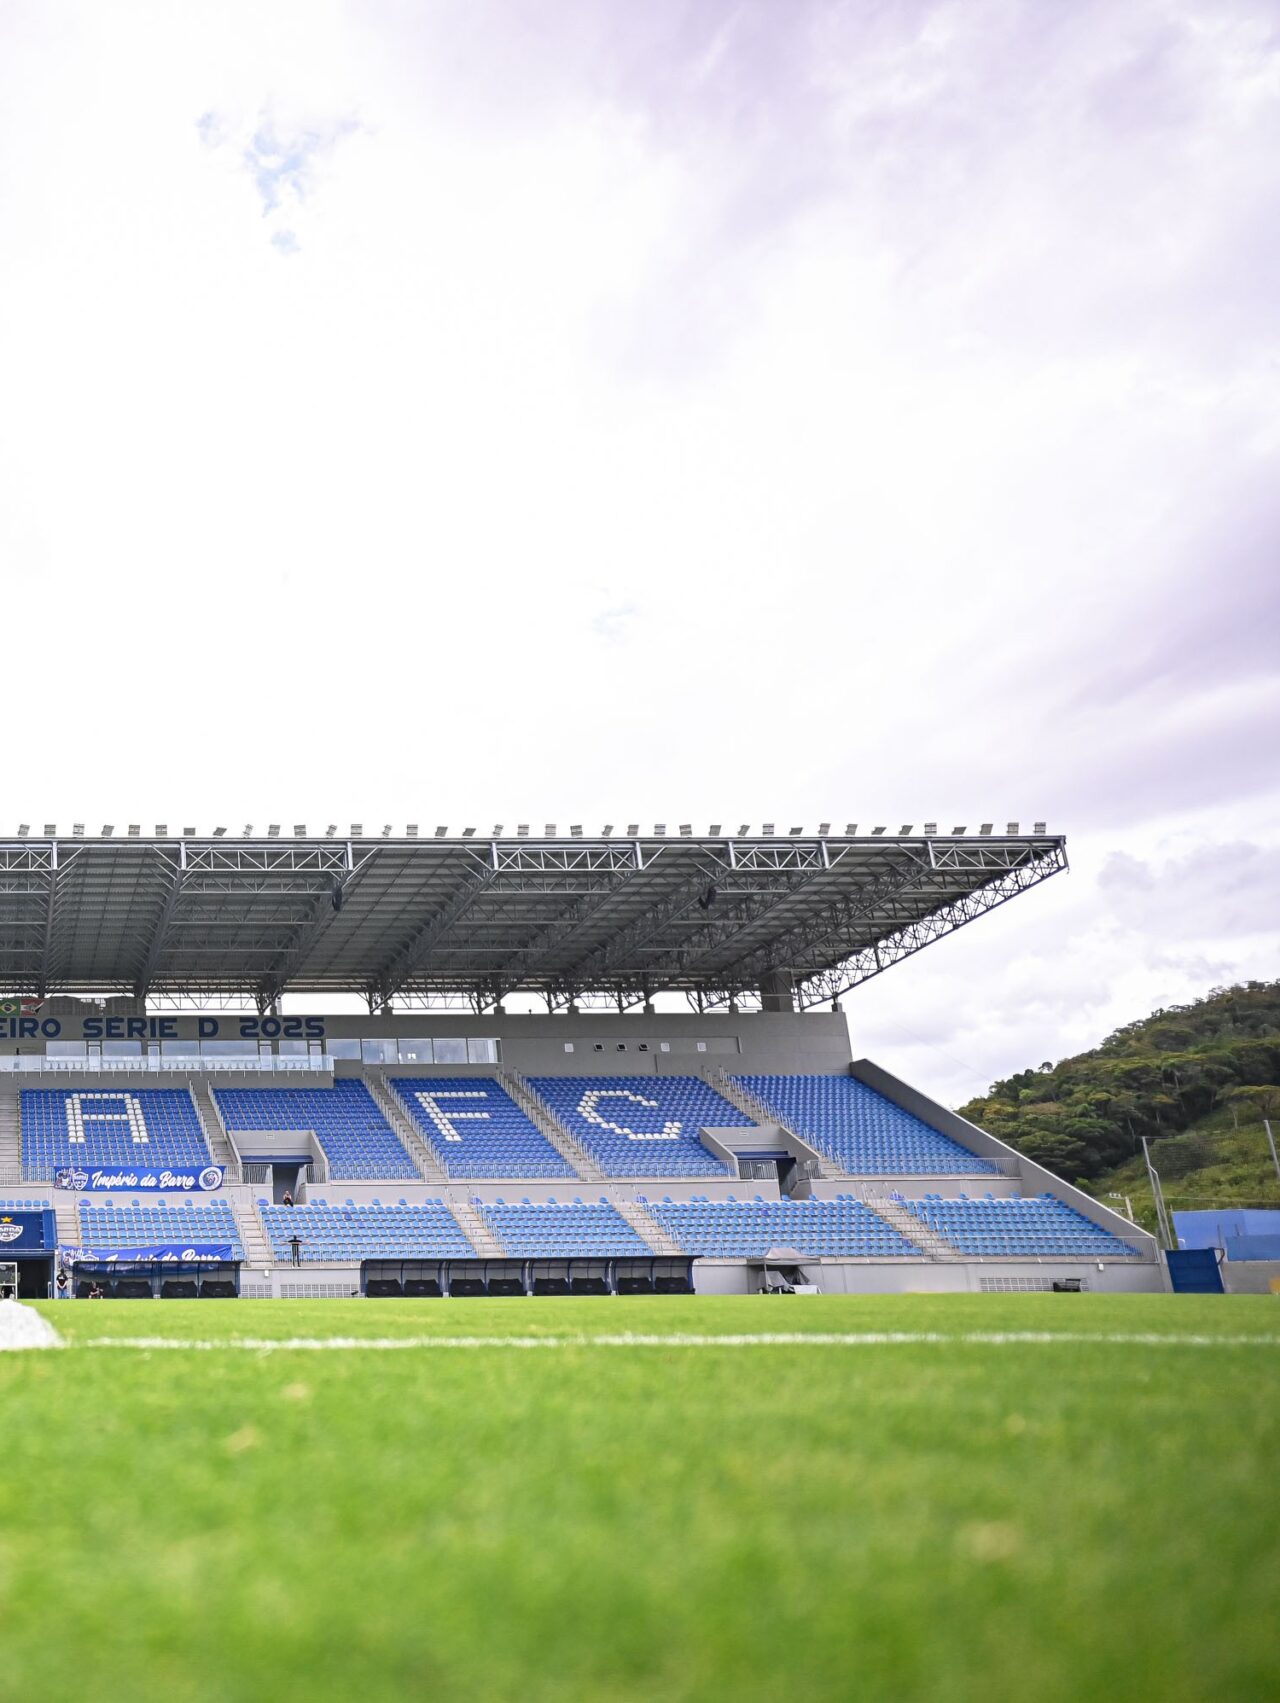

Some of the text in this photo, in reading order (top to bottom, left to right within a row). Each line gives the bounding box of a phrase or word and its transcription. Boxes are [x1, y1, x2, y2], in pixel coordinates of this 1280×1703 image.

[198, 1017, 219, 1038] D
[238, 1017, 326, 1038] 2025
[91, 1171, 196, 1190] Império da Barra
